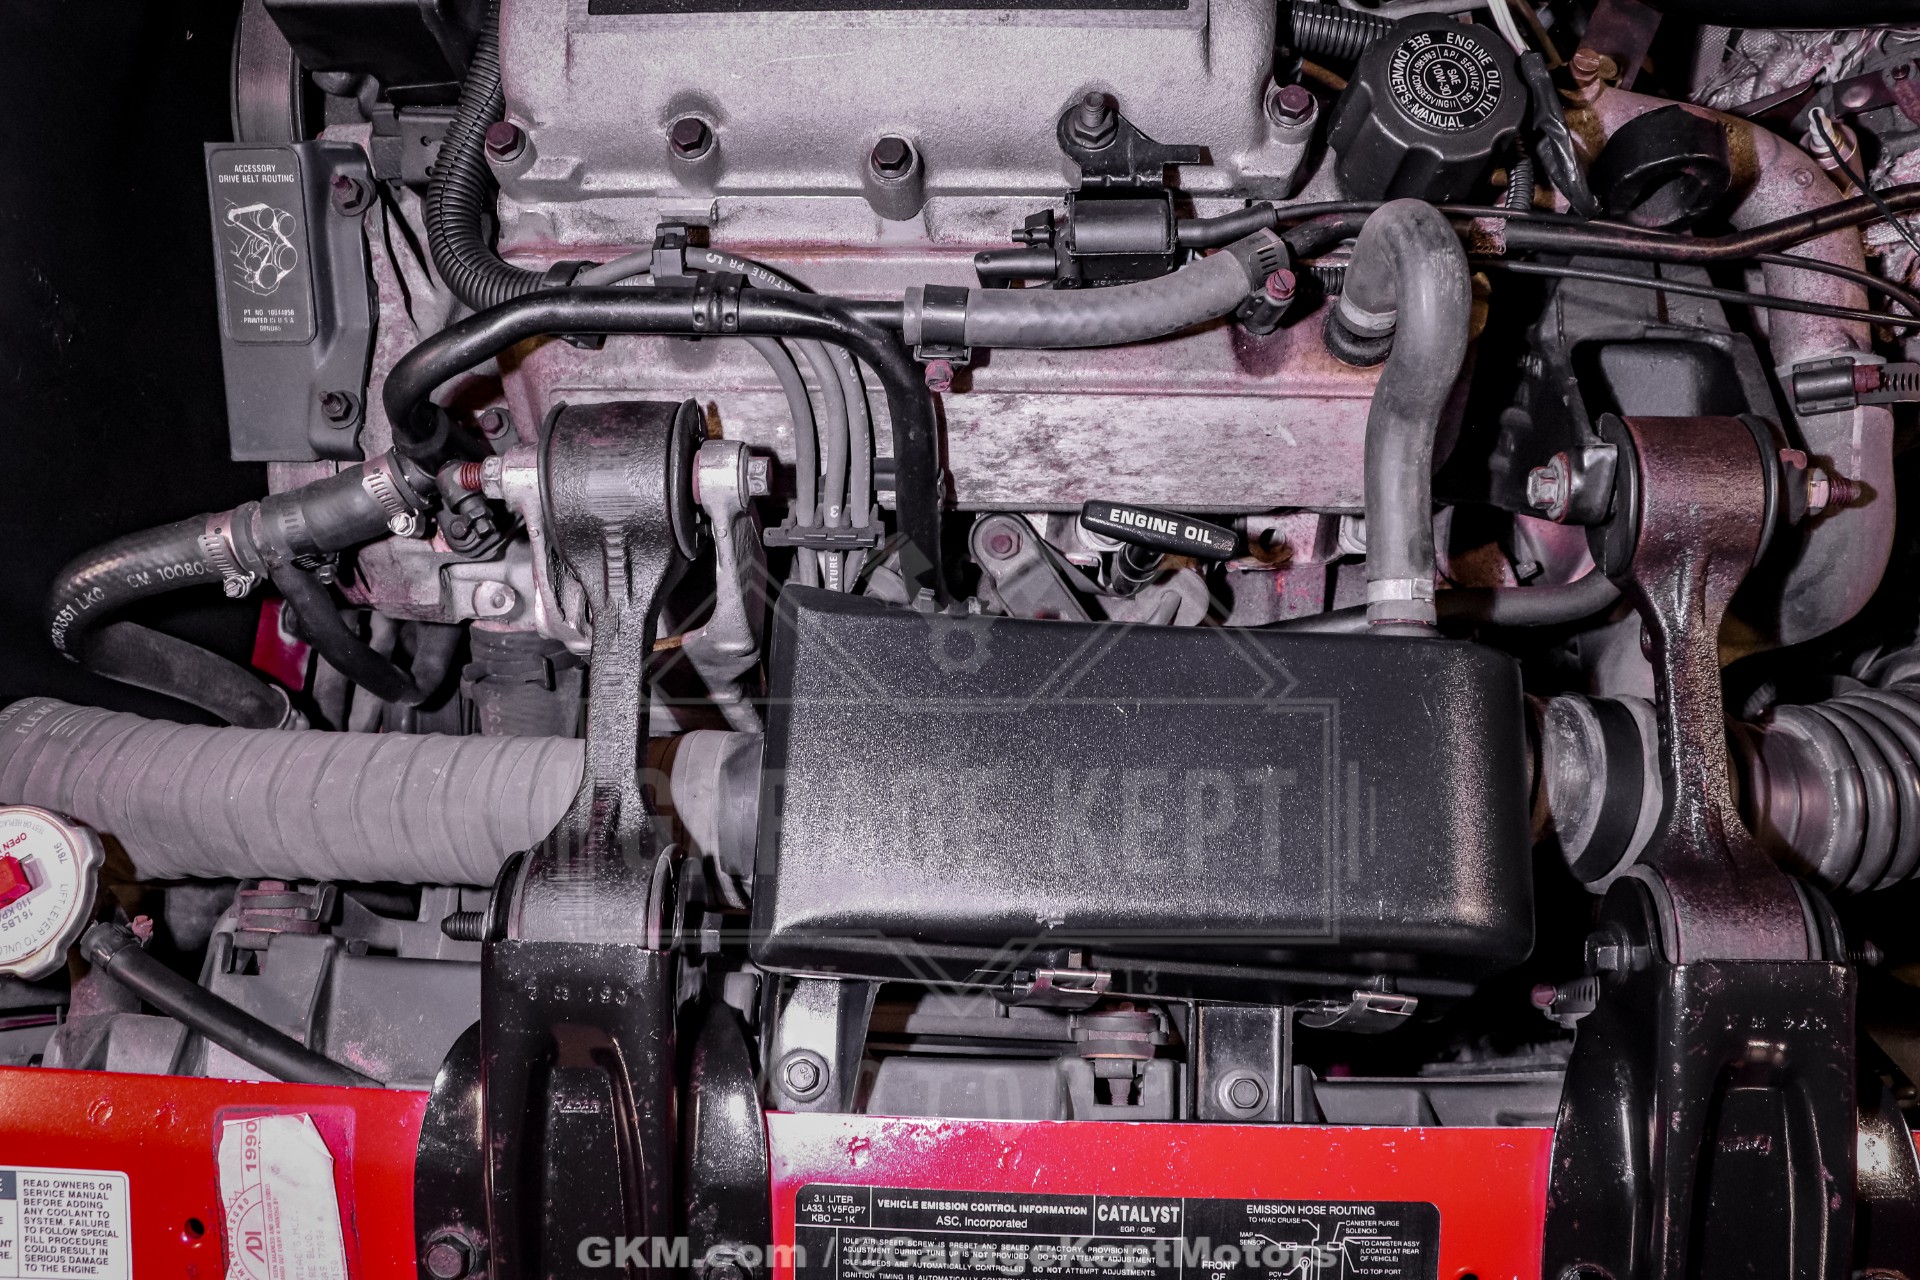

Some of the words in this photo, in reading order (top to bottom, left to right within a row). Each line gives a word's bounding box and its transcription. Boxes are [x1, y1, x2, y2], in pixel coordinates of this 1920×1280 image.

[1408, 33, 1432, 50] SEE
[1446, 32, 1493, 66] ENGINE
[1391, 49, 1413, 104] OWNER'S
[1443, 49, 1459, 60] API
[1460, 57, 1480, 91] SERVICE
[1447, 68, 1461, 86] SAE
[1431, 63, 1452, 96] 10W-30
[1486, 70, 1500, 90] OIL
[1474, 93, 1498, 117] FILL
[1410, 102, 1465, 128] MANUAL
[234, 164, 276, 173] ACCESSORY
[218, 174, 240, 183] DRIVE
[242, 174, 260, 183] BELT
[262, 174, 295, 183] ROUTING
[1109, 508, 1179, 536] ENGINE
[1184, 526, 1213, 545] OIL
[2, 832, 27, 851] OPEN
[59, 883, 69, 906] LIFT
[2, 914, 24, 932] LBS
[38, 906, 61, 937] LEVER
[244, 1120, 258, 1173] 1990
[23, 1179, 49, 1188] READ
[53, 1180, 95, 1190] OWNERS
[98, 1182, 112, 1191] OR
[23, 1188, 65, 1198] SERVICE
[68, 1190, 109, 1200] MANUAL
[813, 1194, 825, 1203] 3.1
[828, 1195, 854, 1204] LITER
[23, 1198, 63, 1207] BEFORE
[66, 1200, 104, 1209] ADDING
[826, 1205, 866, 1214] 1V5FGP7
[877, 1199, 919, 1210] VEHICLE
[920, 1200, 969, 1211] EMISSION
[970, 1202, 1017, 1213] CONTROL
[1018, 1204, 1088, 1216] INFORMATION
[1246, 1204, 1296, 1215] EMISSION
[1298, 1205, 1327, 1215] HOSE
[1329, 1205, 1376, 1216] ROUTING
[23, 1207, 43, 1216] ANY
[47, 1208, 93, 1218] COOLANT
[97, 1210, 110, 1219] TO
[844, 1215, 856, 1224] 1K
[1097, 1204, 1180, 1224] CATALYST
[23, 1217, 66, 1226] SYSTEM.
[69, 1218, 110, 1228] FAILURE
[935, 1215, 962, 1228] ASC,
[964, 1216, 1028, 1230] Incorporated
[1120, 1225, 1135, 1233] EGR
[24, 1226, 37, 1234] TO
[39, 1226, 78, 1236] FOLLOW
[80, 1228, 119, 1238] SPECIAL
[24, 1235, 45, 1244] FILL
[48, 1236, 109, 1246] PROCEDURE
[842, 1237, 859, 1245] IDLE
[907, 1240, 935, 1248] SCREW
[949, 1241, 978, 1249] PRESET
[1000, 1243, 1030, 1251] SEALED
[1046, 1245, 1084, 1253] FACTORY.
[1087, 1246, 1129, 1255] PROVISION
[24, 1244, 57, 1254] COULD
[60, 1246, 96, 1255] RESULT
[99, 1248, 109, 1256] IN
[842, 1246, 891, 1255] ADJUSTMENT
[894, 1248, 923, 1256] DURING
[926, 1249, 946, 1257] TUNE
[991, 1251, 1031, 1260] PROVIDED.
[1037, 1253, 1048, 1261] DO
[1070, 1254, 1105, 1262] ATTEMPT
[1108, 1255, 1158, 1264] ADJUSTMENT.
[24, 1254, 66, 1263] SERIOUS
[69, 1255, 109, 1265] DAMAGE
[1201, 1260, 1237, 1270] FRONT
[25, 1263, 38, 1272] TO
[41, 1264, 59, 1273] THE
[62, 1265, 100, 1274] ENGINE.
[842, 1271, 875, 1280] IGNITION
[878, 1272, 904, 1280] TIMING
[862, 1259, 891, 1267] SPEEDS
[894, 1260, 909, 1268] ARE
[912, 1261, 972, 1270] AUTOMATICALLY
[975, 1264, 1025, 1272] CONTROLLED.
[1046, 1266, 1062, 1274] NOT
[1065, 1267, 1099, 1275] ATTEMPT
[1102, 1268, 1157, 1277] ADJUSTMENTS.
